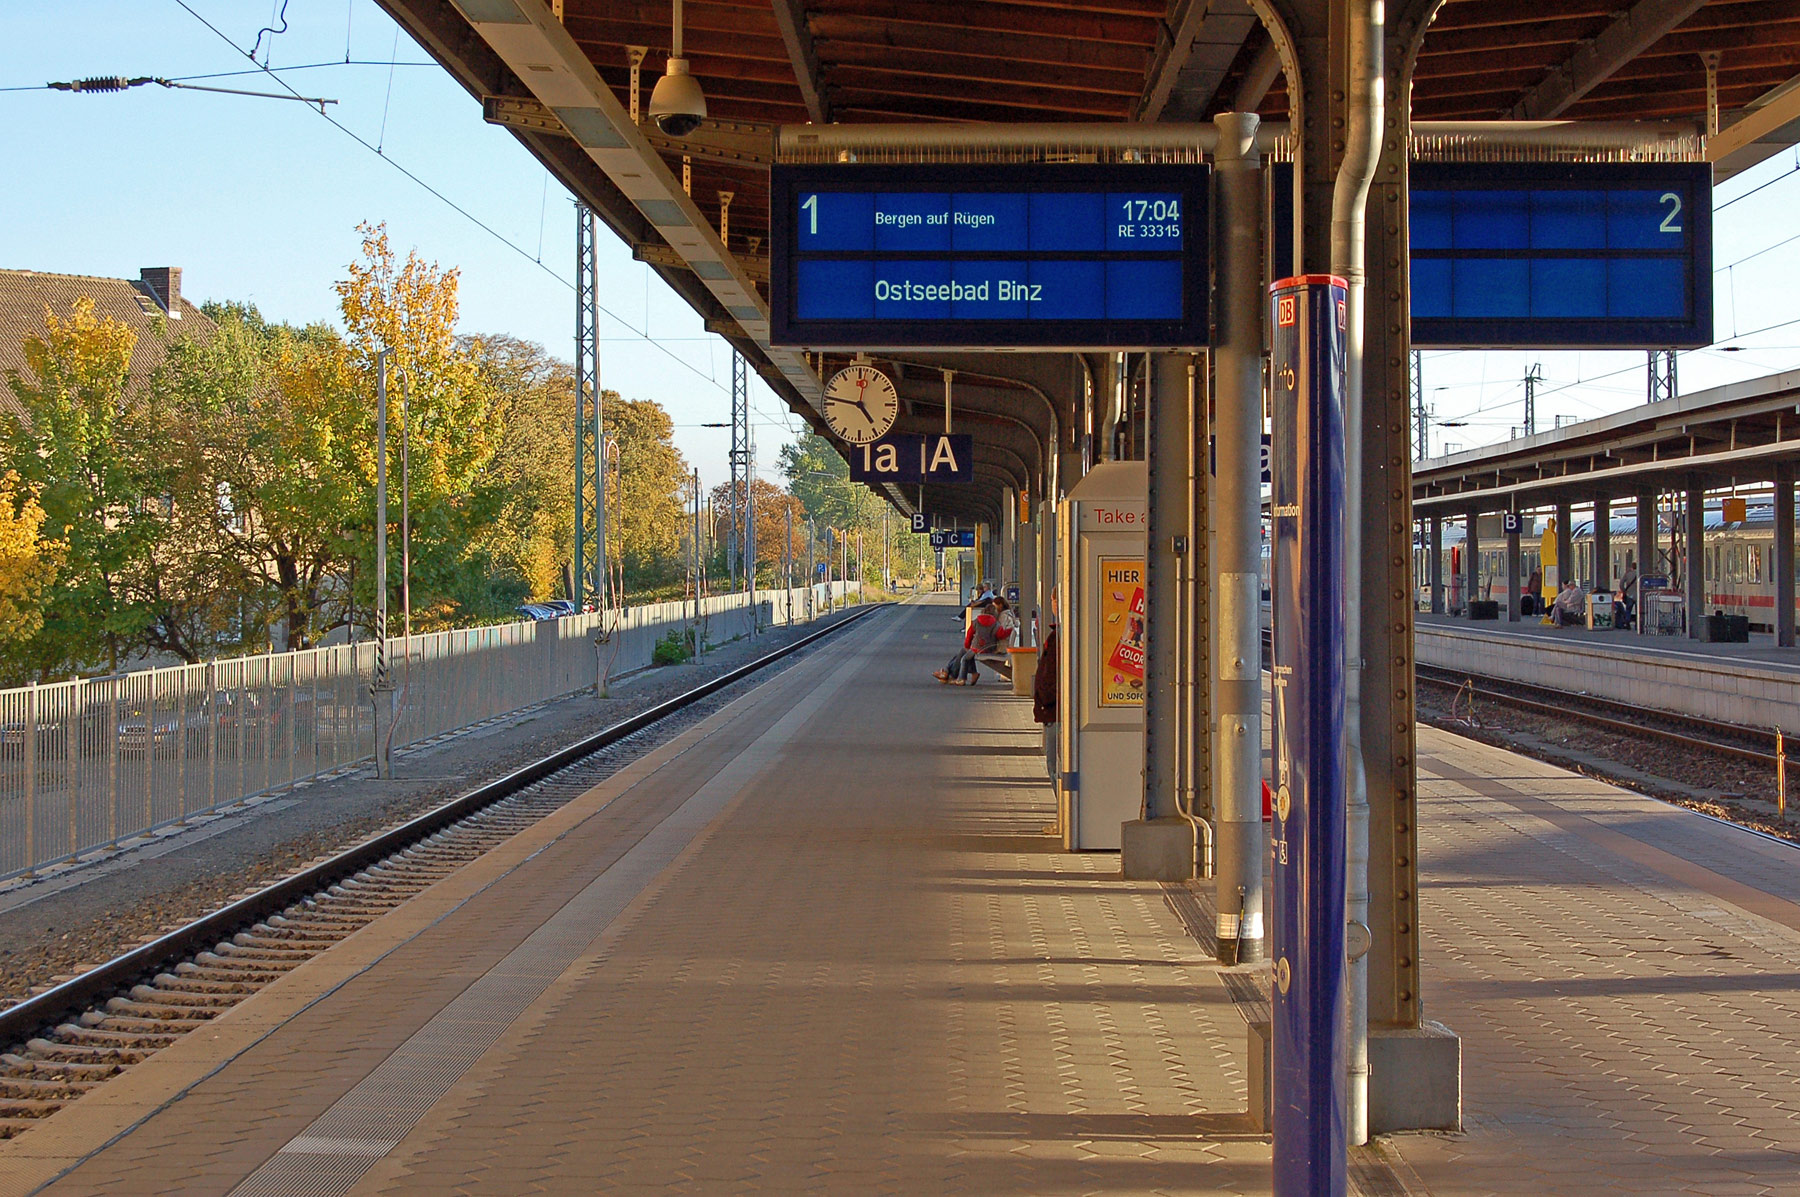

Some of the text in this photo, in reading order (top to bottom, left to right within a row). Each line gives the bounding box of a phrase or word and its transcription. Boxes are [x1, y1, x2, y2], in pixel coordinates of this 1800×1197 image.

[801, 194, 817, 234] 1
[1122, 200, 1180, 221] 17:04
[1659, 193, 1682, 233] 2
[875, 211, 995, 227] Bergen auf Rügen
[1118, 224, 1180, 238] RE 33315
[875, 280, 1042, 301] Ostseebad Binz
[1280, 300, 1293, 323] DB
[856, 436, 959, 472] 1a A
[913, 514, 925, 529] B
[1093, 508, 1135, 524] Take
[1505, 514, 1517, 529] B
[931, 534, 943, 544] 1b
[950, 534, 958, 544] C
[1107, 570, 1139, 583] HIER
[1107, 692, 1124, 700] UND
